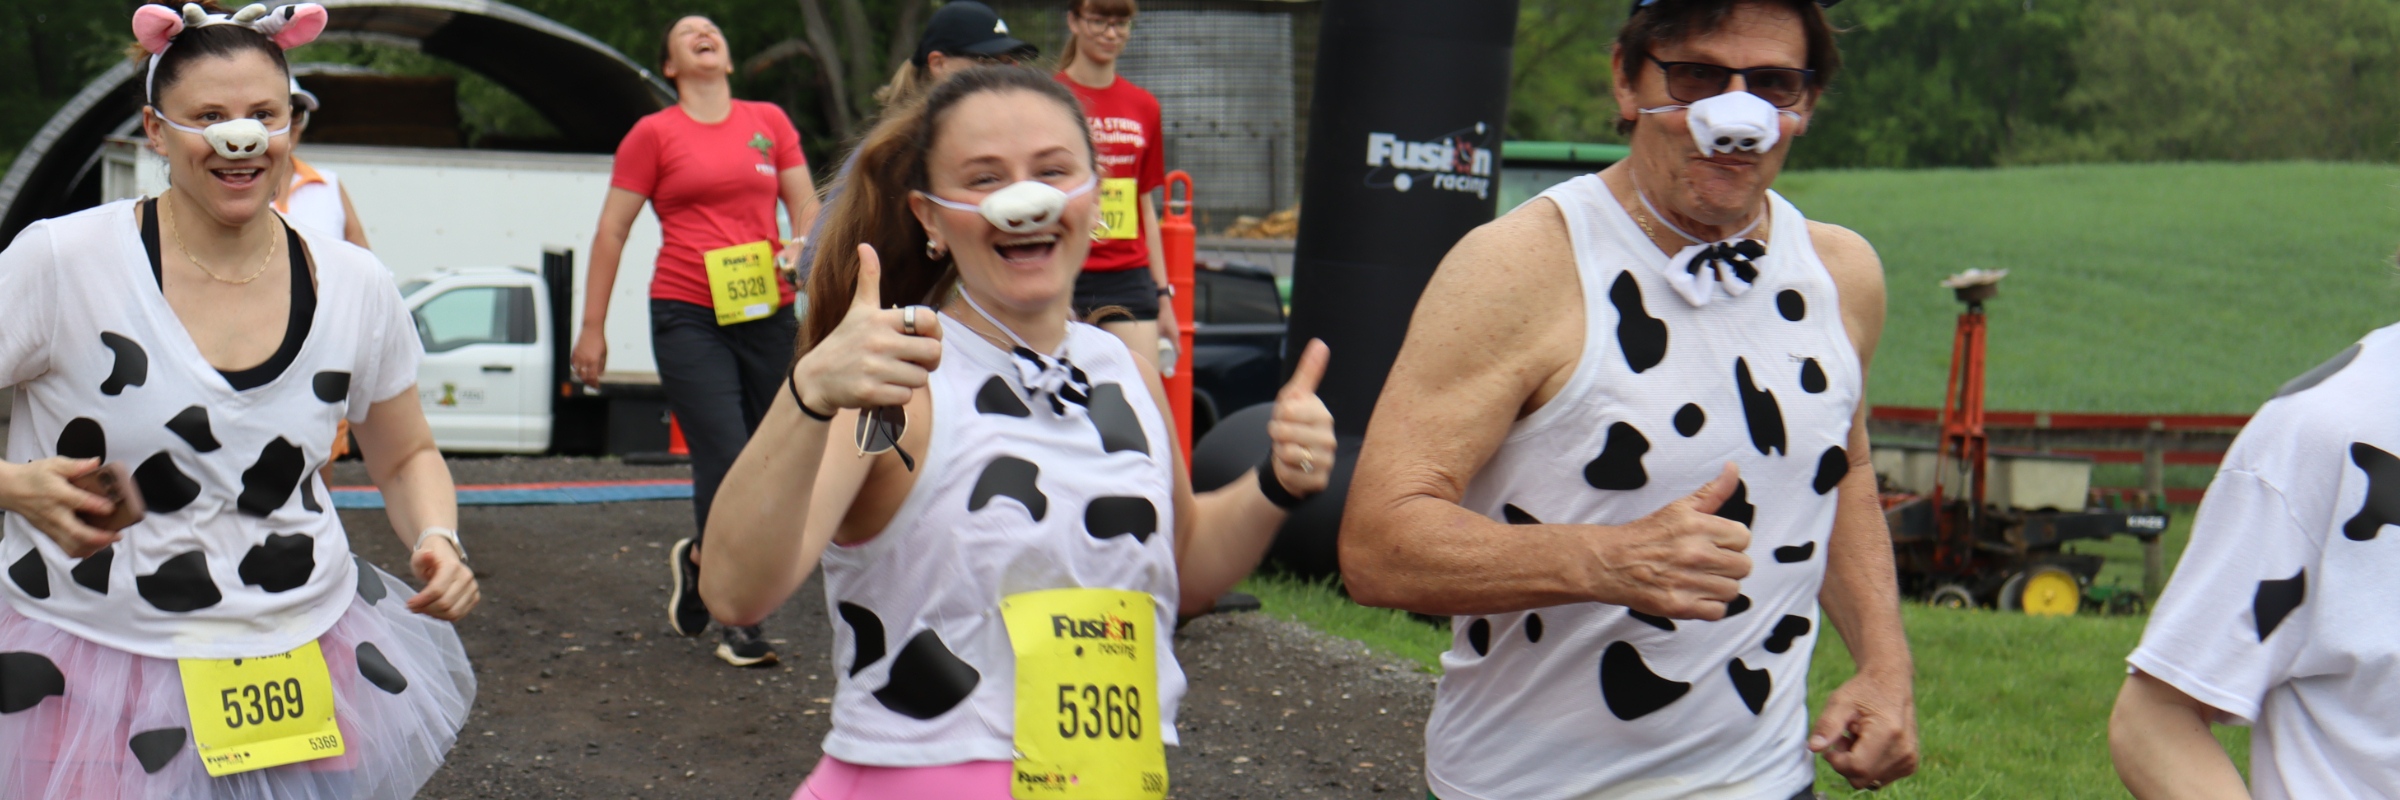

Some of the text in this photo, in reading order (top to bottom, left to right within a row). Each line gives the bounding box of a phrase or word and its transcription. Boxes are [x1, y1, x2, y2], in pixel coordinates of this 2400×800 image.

[1366, 132, 1492, 176] Fusion
[1433, 174, 1489, 200] racing
[727, 275, 767, 301] 5328
[1051, 613, 1136, 641] Fusion
[221, 677, 304, 729] 5369
[1058, 684, 1142, 740] 5368
[308, 734, 338, 751] 5369
